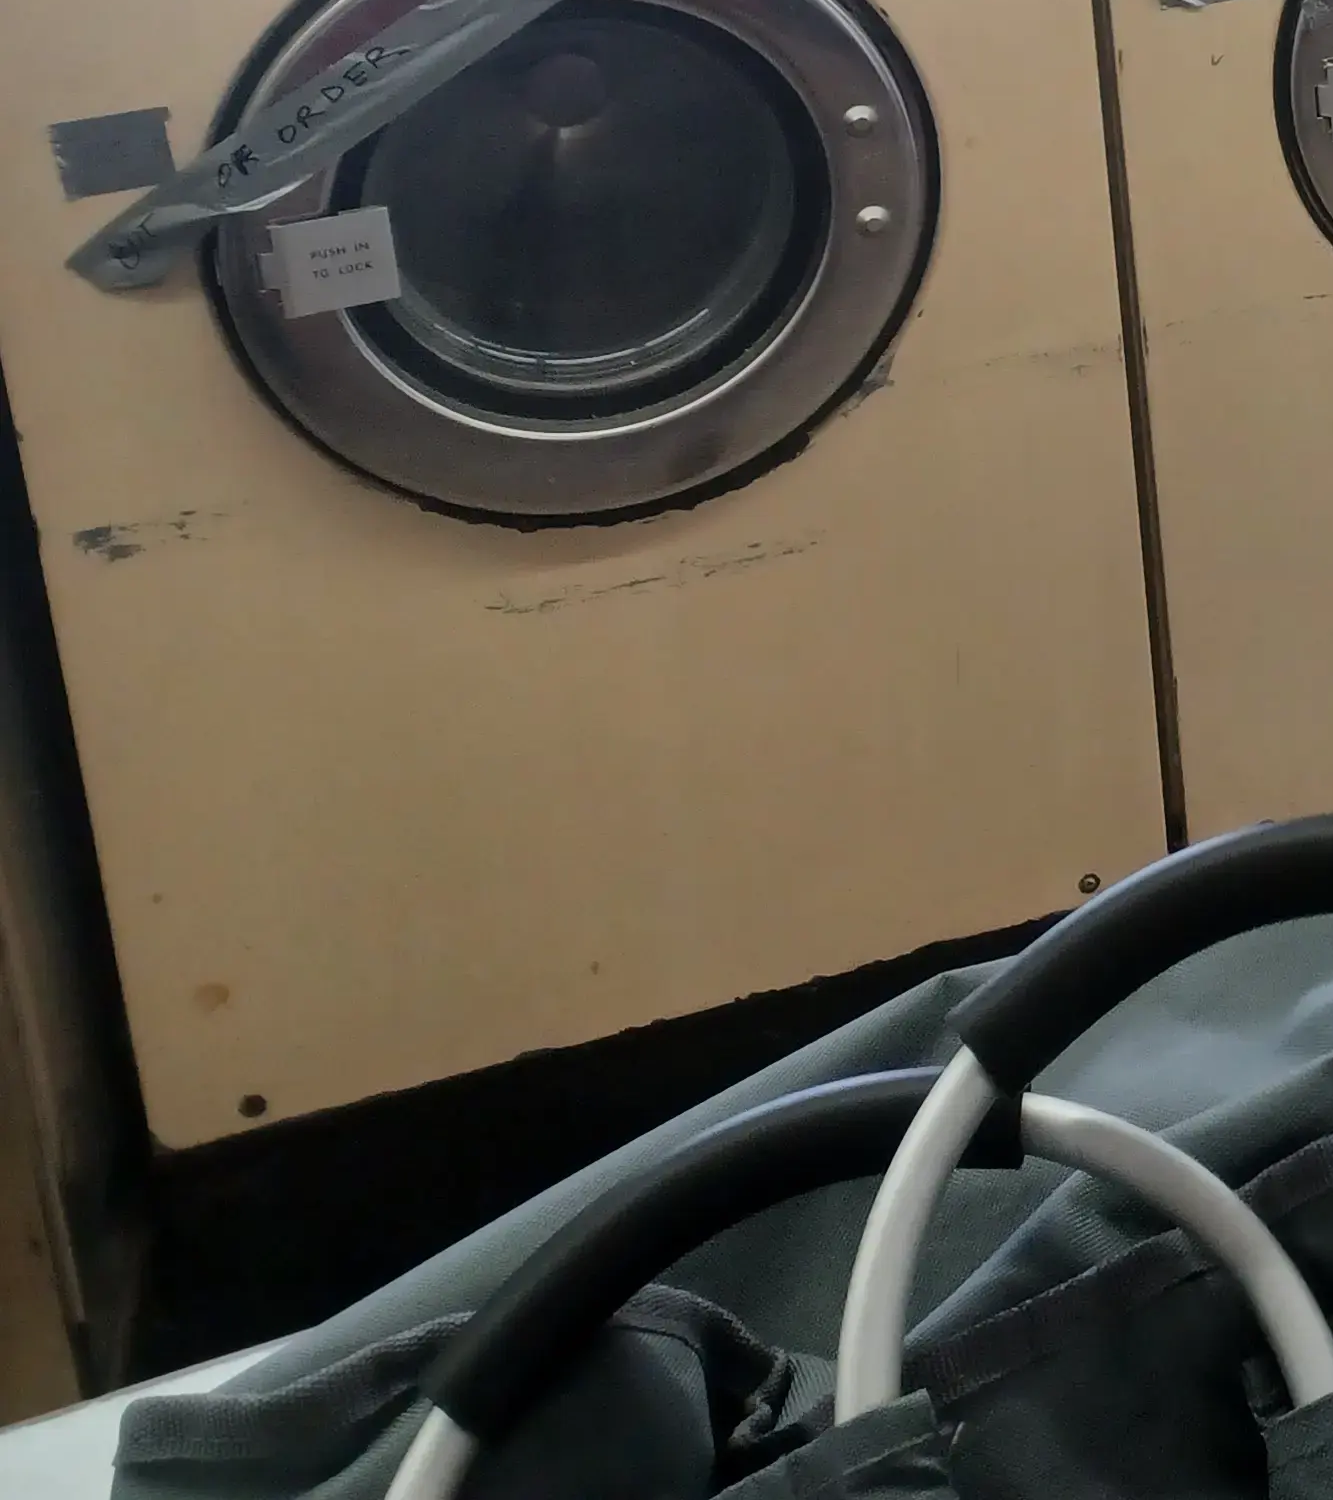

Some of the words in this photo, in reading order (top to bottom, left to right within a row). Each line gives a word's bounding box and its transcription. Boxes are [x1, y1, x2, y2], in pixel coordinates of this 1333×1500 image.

[276, 44, 412, 145] ORDER
[308, 244, 348, 261] PUSH
[353, 240, 371, 256] IN
[311, 265, 333, 280] TO
[337, 259, 374, 276] LOCK
